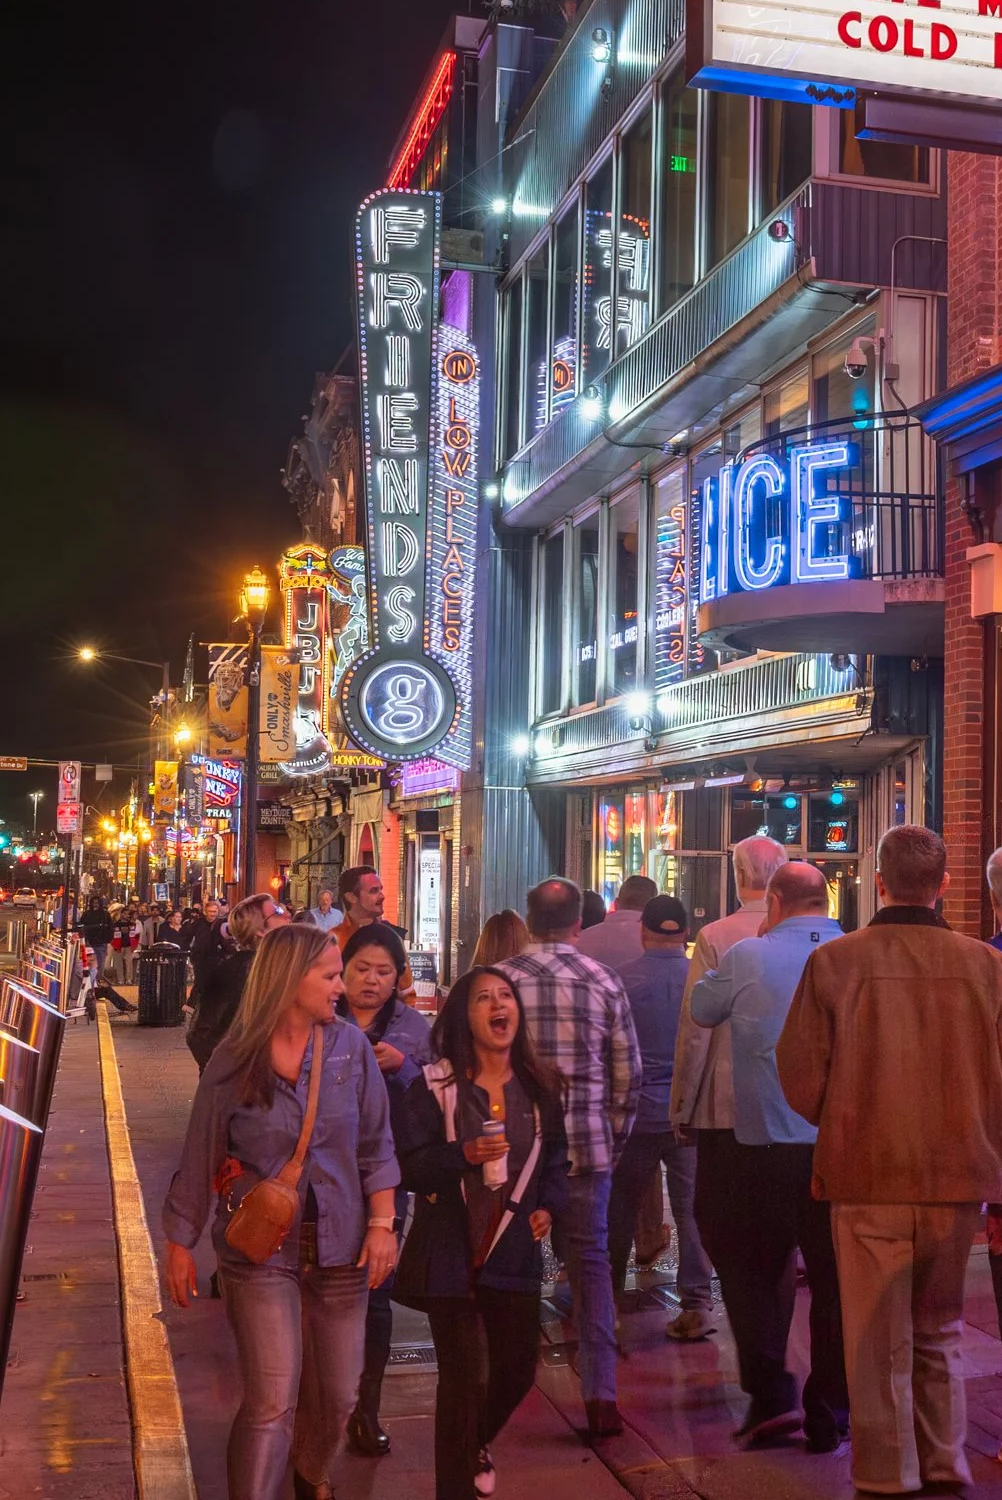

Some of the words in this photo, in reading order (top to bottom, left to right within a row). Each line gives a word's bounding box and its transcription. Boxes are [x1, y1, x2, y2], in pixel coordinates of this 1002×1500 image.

[837, 11, 958, 60] COLD
[671, 155, 687, 172] EXIT
[452, 359, 468, 377] IN
[370, 206, 427, 643] FRIENDS
[443, 397, 471, 477] LOW
[442, 489, 465, 651] PLACES
[270, 669, 292, 752] Smashville
[382, 672, 427, 732] g
[267, 703, 278, 729] ONLY
[205, 760, 239, 783] ONKY
[333, 755, 361, 767] HONKY
[261, 771, 278, 779] GRILL
[205, 778, 226, 798] NK
[206, 808, 232, 818] TRAL
